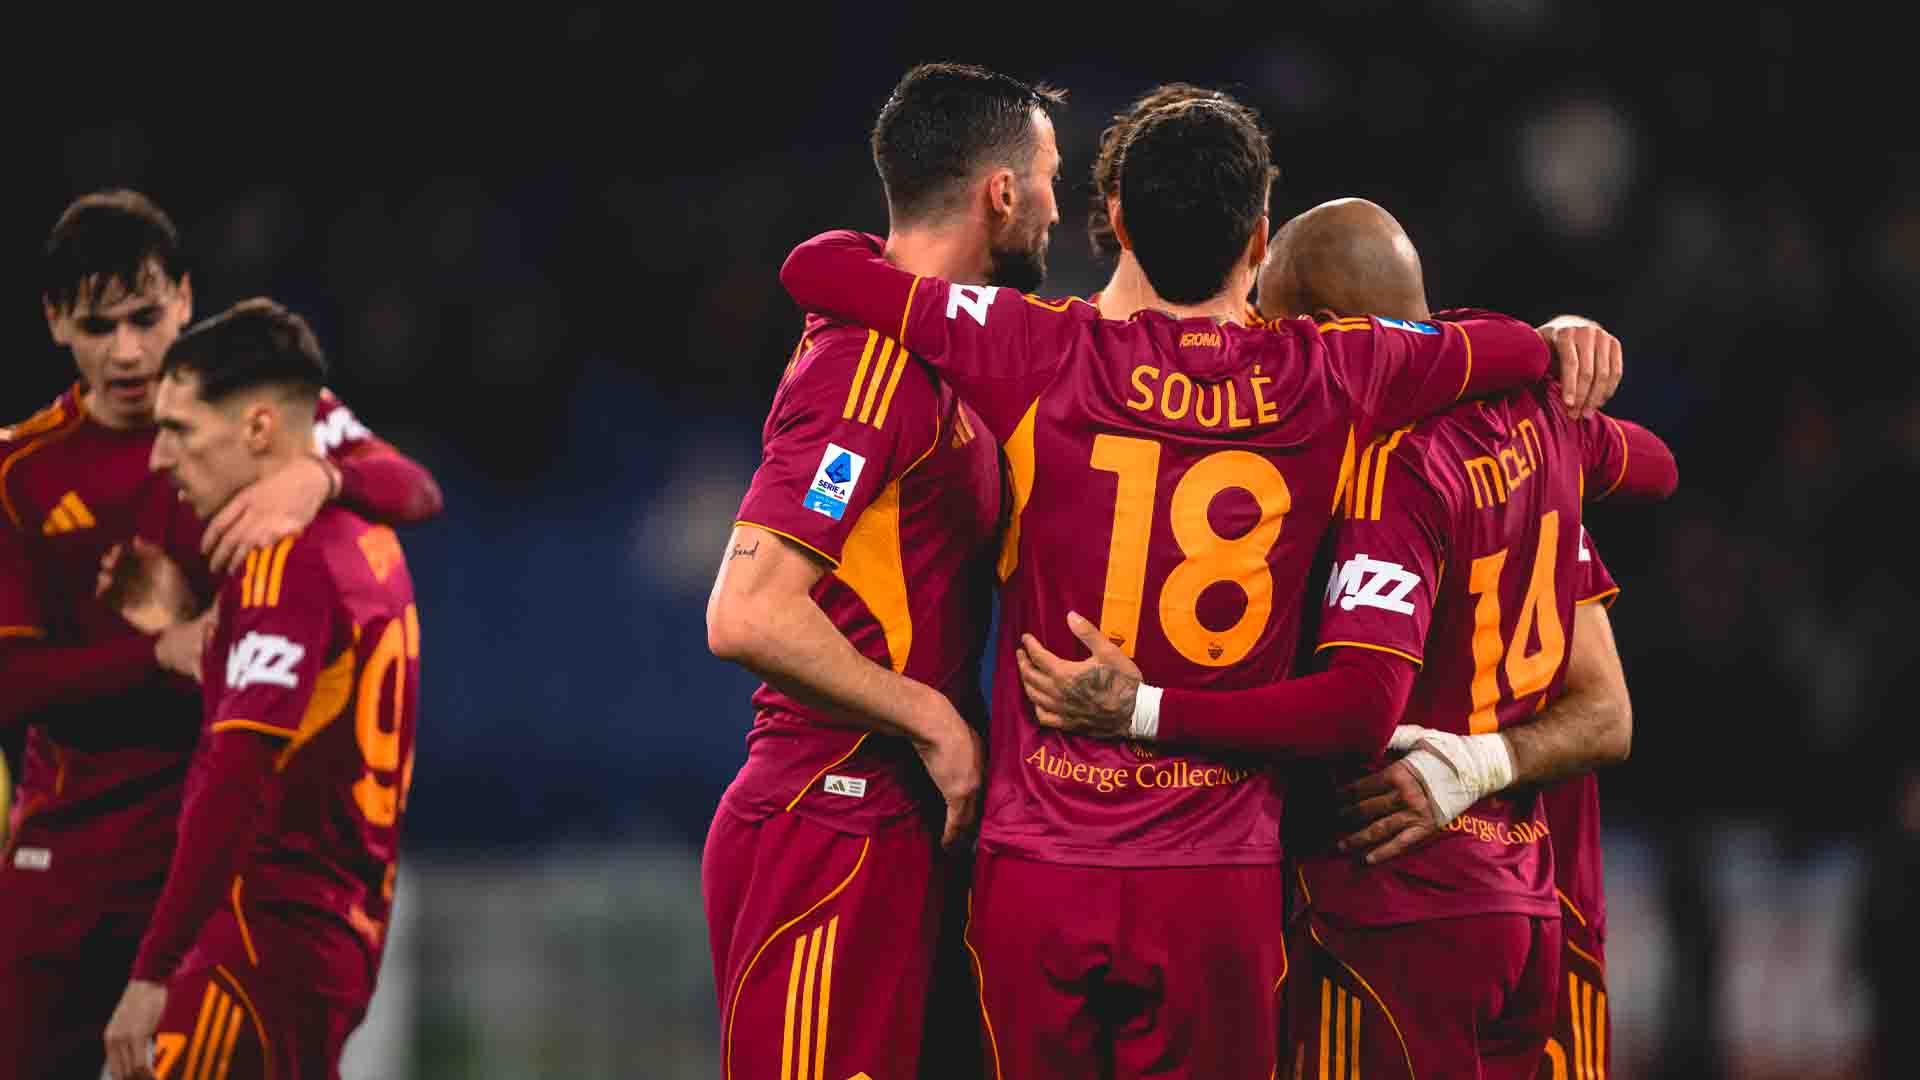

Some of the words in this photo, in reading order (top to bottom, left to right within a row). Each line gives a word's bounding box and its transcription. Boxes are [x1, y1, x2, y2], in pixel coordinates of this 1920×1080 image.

[1126, 364, 1281, 428] SOULÉ
[817, 479, 841, 494] SERIE
[1090, 433, 1291, 667] 18
[1469, 510, 1565, 735] 14
[1025, 744, 1129, 793] Auberge
